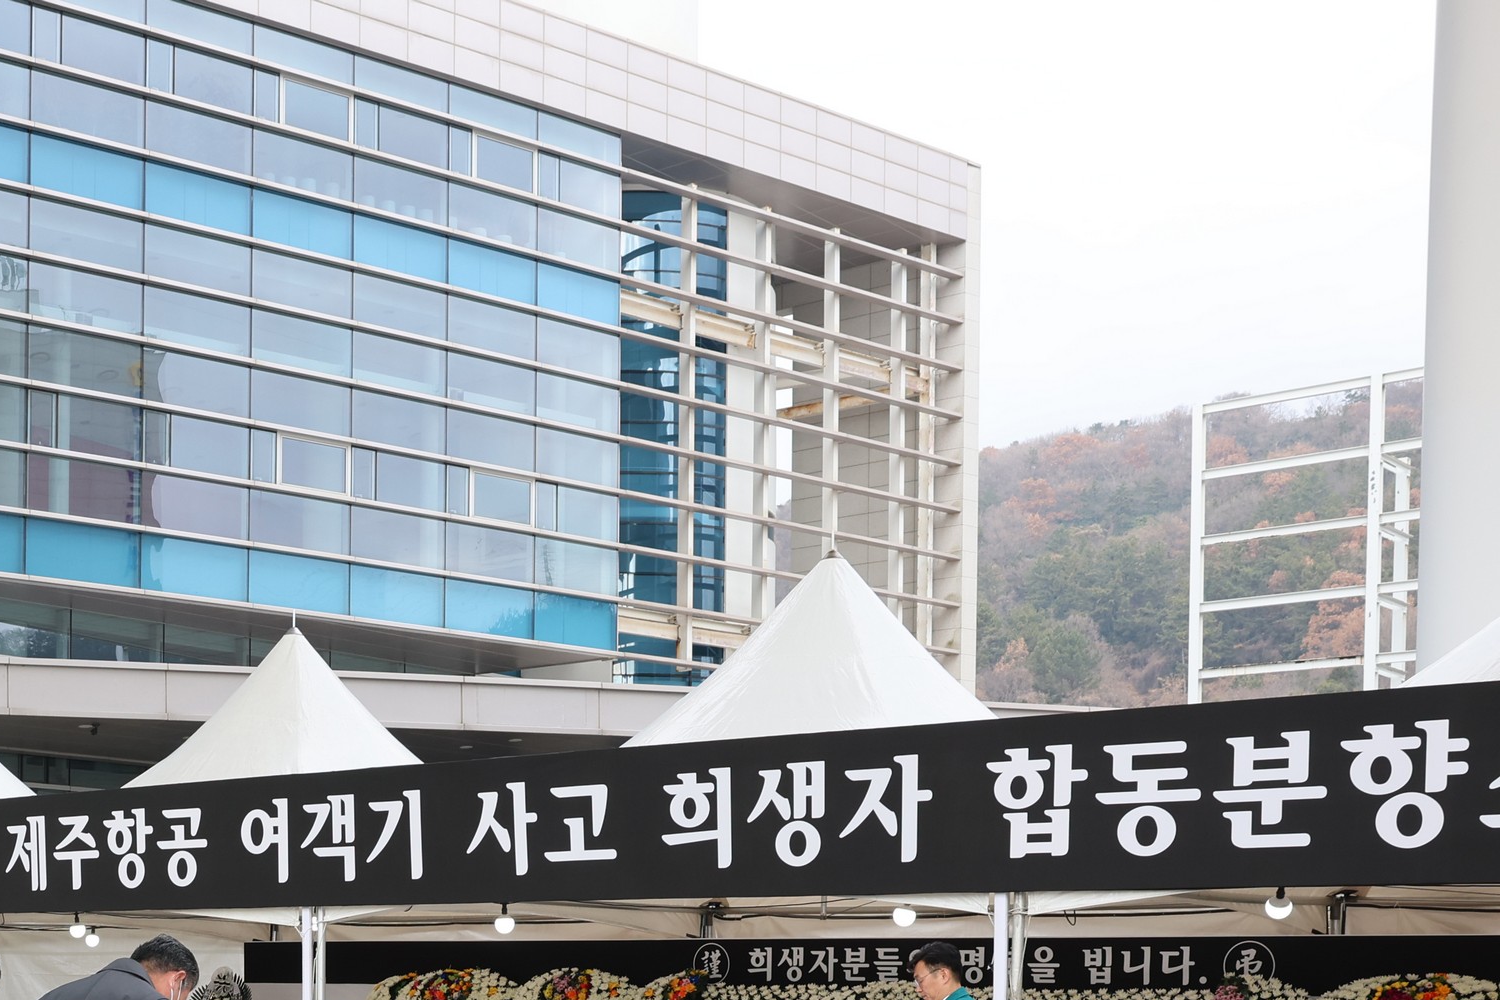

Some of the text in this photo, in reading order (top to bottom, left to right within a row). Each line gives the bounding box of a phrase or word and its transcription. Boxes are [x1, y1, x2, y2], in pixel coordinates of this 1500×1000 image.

[6, 807, 208, 892] 제주항공
[241, 789, 424, 883] 여객기
[467, 781, 618, 876] 사고
[661, 753, 933, 869] 희생자
[747, 946, 1208, 985] 희생자분들 명을 빕니다.
